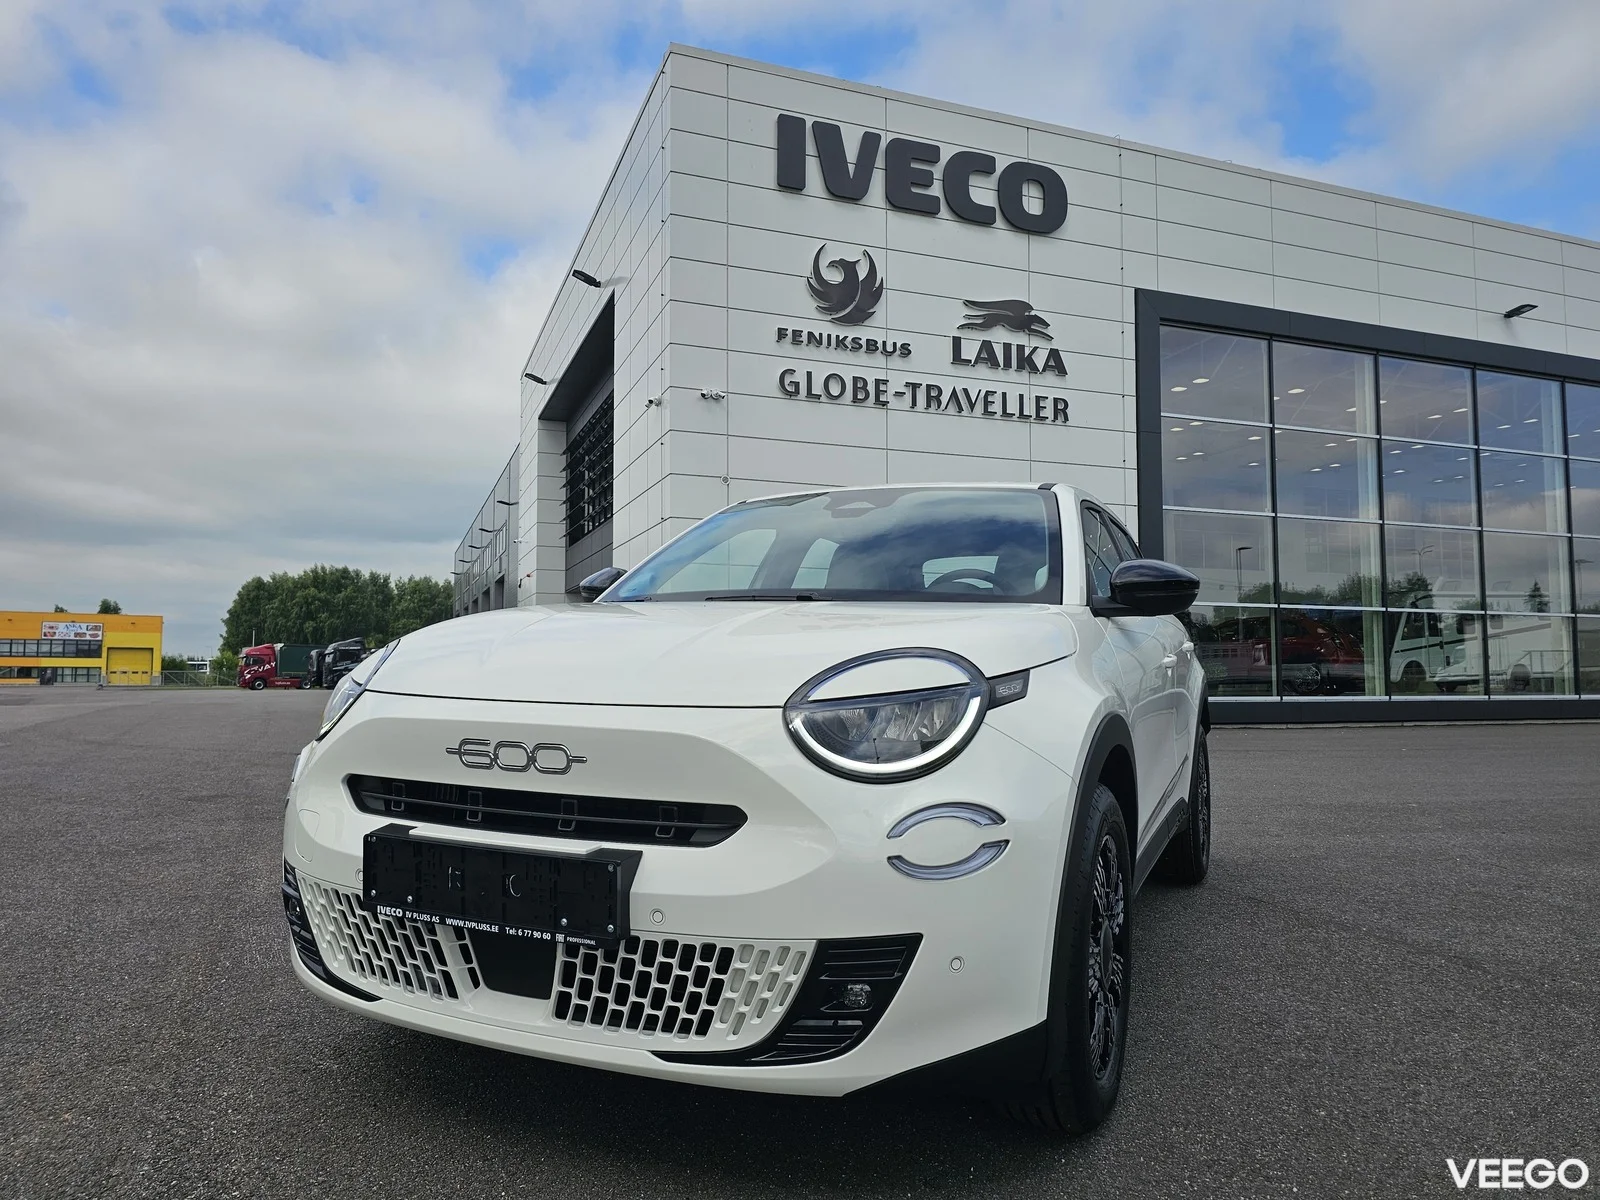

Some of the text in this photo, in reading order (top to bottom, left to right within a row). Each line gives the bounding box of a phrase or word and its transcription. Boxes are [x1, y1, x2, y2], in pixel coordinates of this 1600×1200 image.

[777, 113, 1068, 234] IVECO
[776, 327, 912, 358] FENIKSBUS
[951, 335, 1068, 376] LAIKA
[778, 368, 1069, 424] GLOBE-TRAVELLER
[457, 738, 573, 775] 600
[377, 905, 403, 917] IVECO
[413, 912, 431, 922] PLUSS
[431, 915, 440, 923] AS
[445, 918, 499, 933] WWW.IVPLUSS.EE
[505, 927, 517, 936] Tel:
[532, 931, 541, 939] 90
[566, 936, 596, 945] PROFESSIONAL
